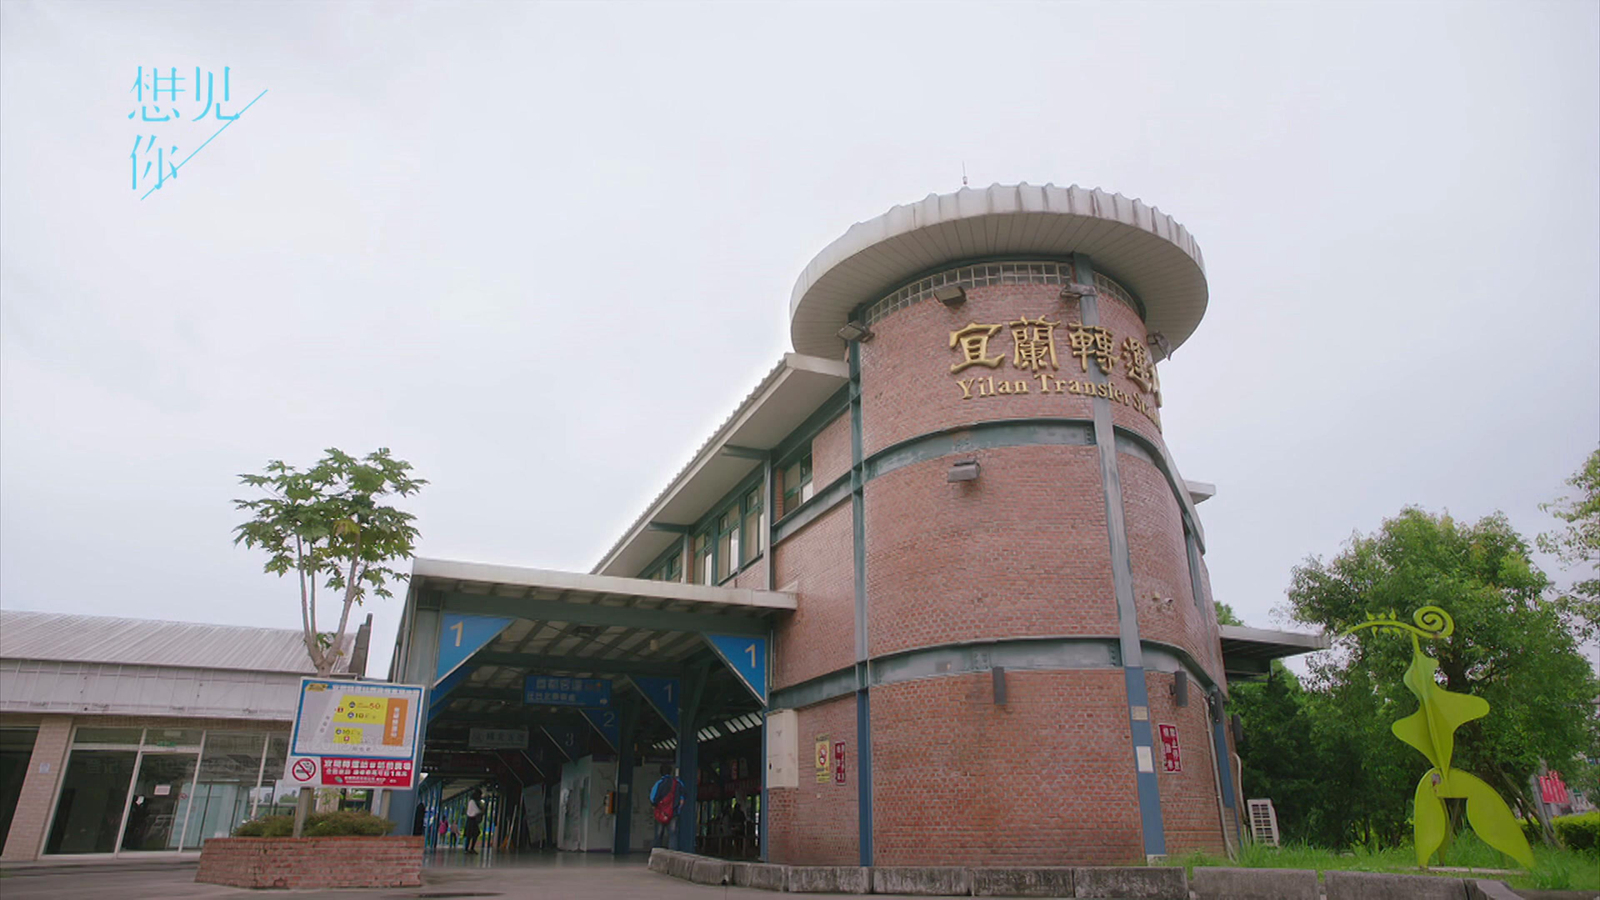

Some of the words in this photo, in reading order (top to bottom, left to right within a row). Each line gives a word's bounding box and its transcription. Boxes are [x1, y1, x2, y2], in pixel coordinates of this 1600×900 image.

[956, 376, 1029, 400] Yilan
[1033, 373, 1130, 407] Transfer
[450, 621, 465, 647] 1
[744, 643, 758, 668] 1
[663, 684, 673, 703] 1
[603, 711, 616, 728] 2
[565, 732, 574, 747] 3
